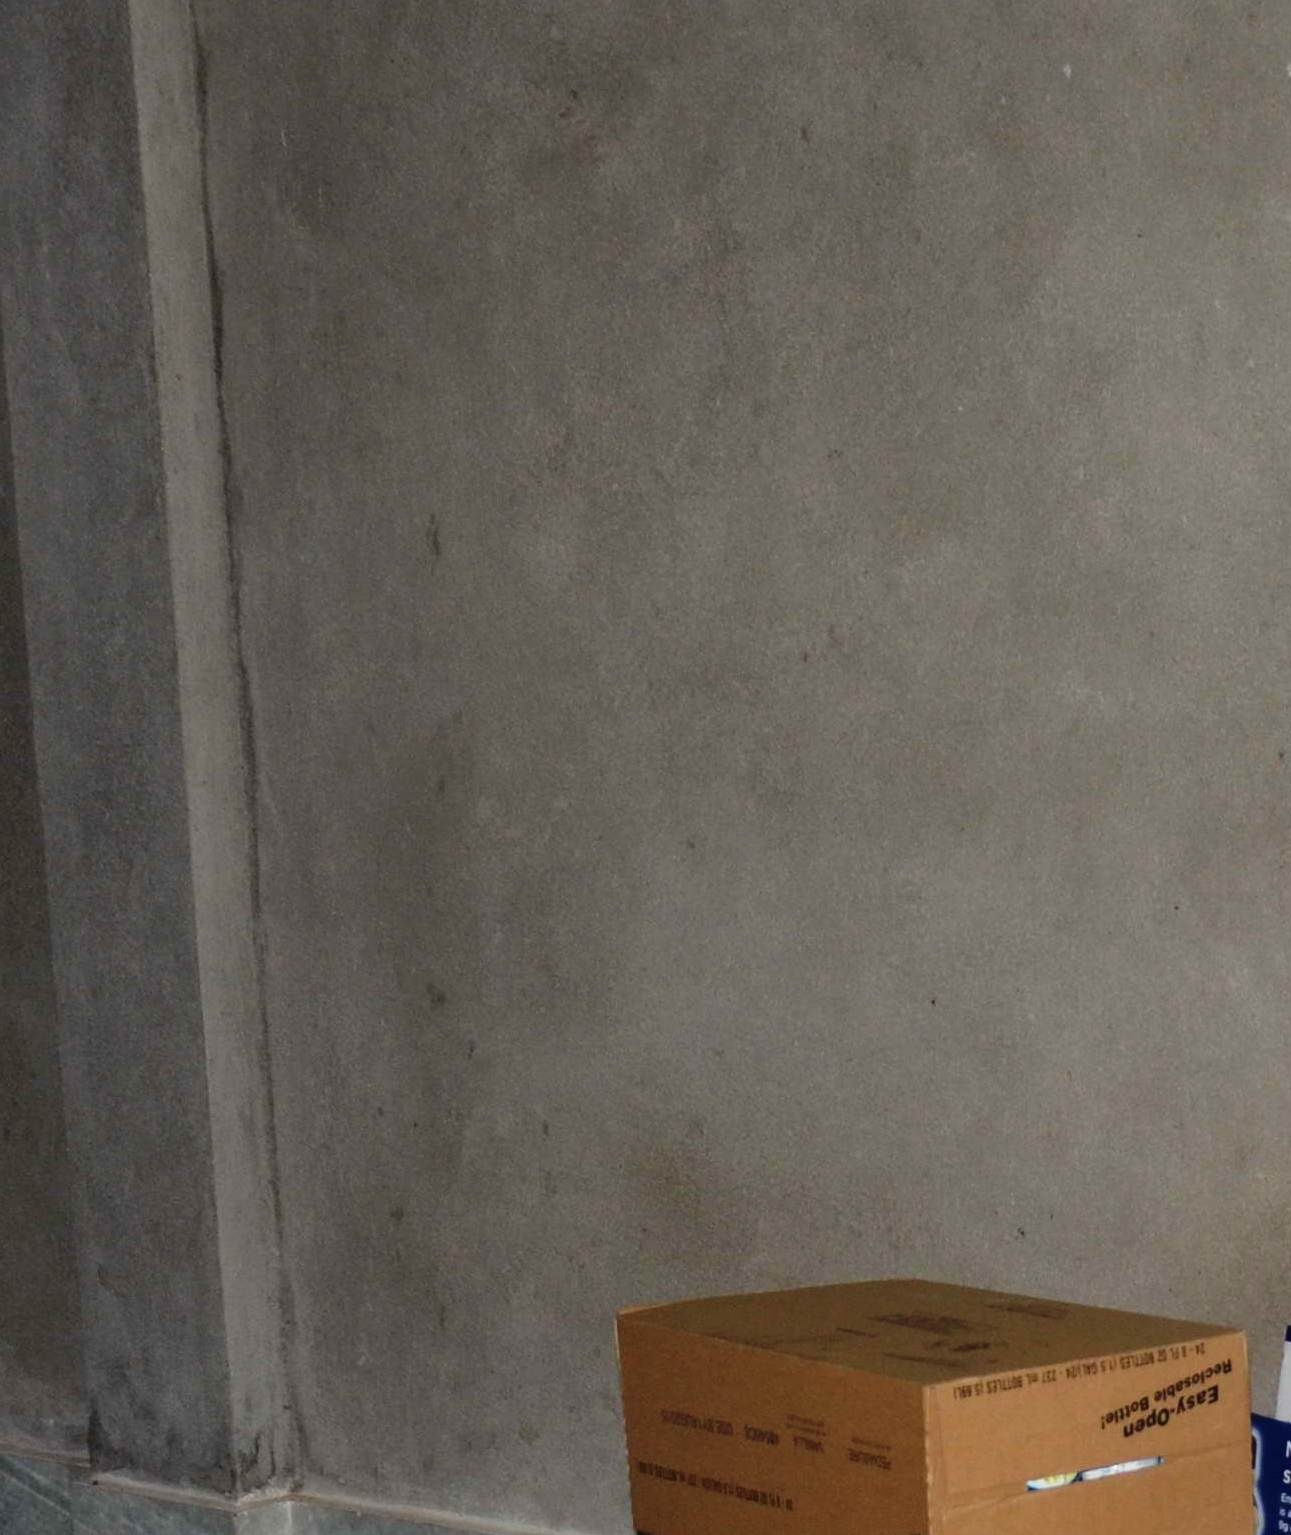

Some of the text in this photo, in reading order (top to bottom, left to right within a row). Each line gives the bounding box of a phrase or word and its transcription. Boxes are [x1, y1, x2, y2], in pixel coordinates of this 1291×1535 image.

[1122, 1352, 1155, 1368] BOTTLES
[987, 1375, 1023, 1394] BOTTLES
[1101, 1359, 1232, 1429] Reclosable Bottle!
[1123, 1384, 1219, 1438] Easy-Open
